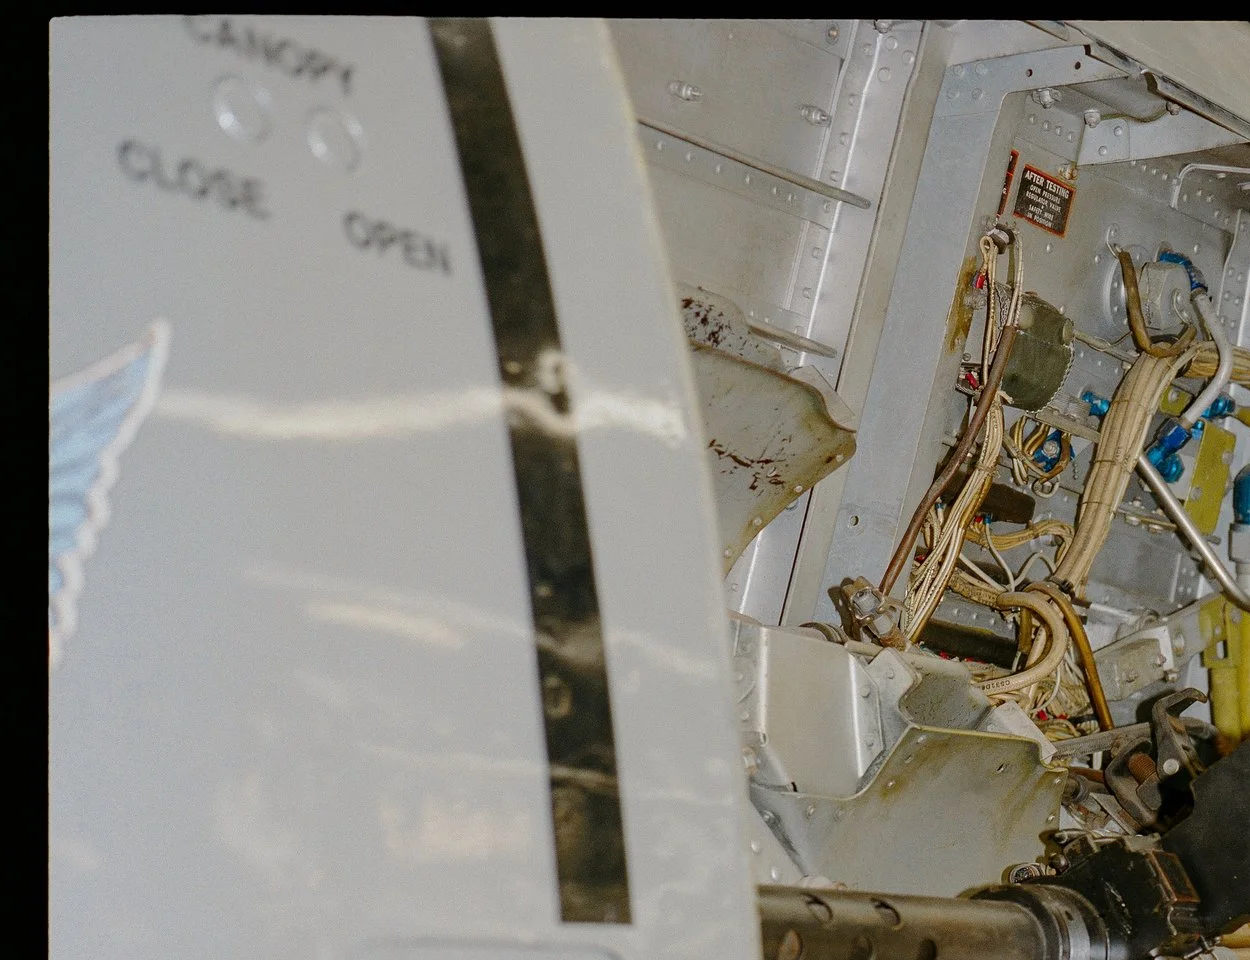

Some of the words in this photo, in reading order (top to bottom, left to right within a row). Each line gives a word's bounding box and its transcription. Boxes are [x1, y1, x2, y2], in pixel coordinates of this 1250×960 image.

[116, 137, 270, 220] CLOSE
[1025, 170, 1044, 187] AFTER
[1046, 180, 1070, 199] TESTING
[1030, 184, 1041, 194] OPEN
[1042, 190, 1061, 204] PRESSURE
[343, 209, 452, 277] OPEN
